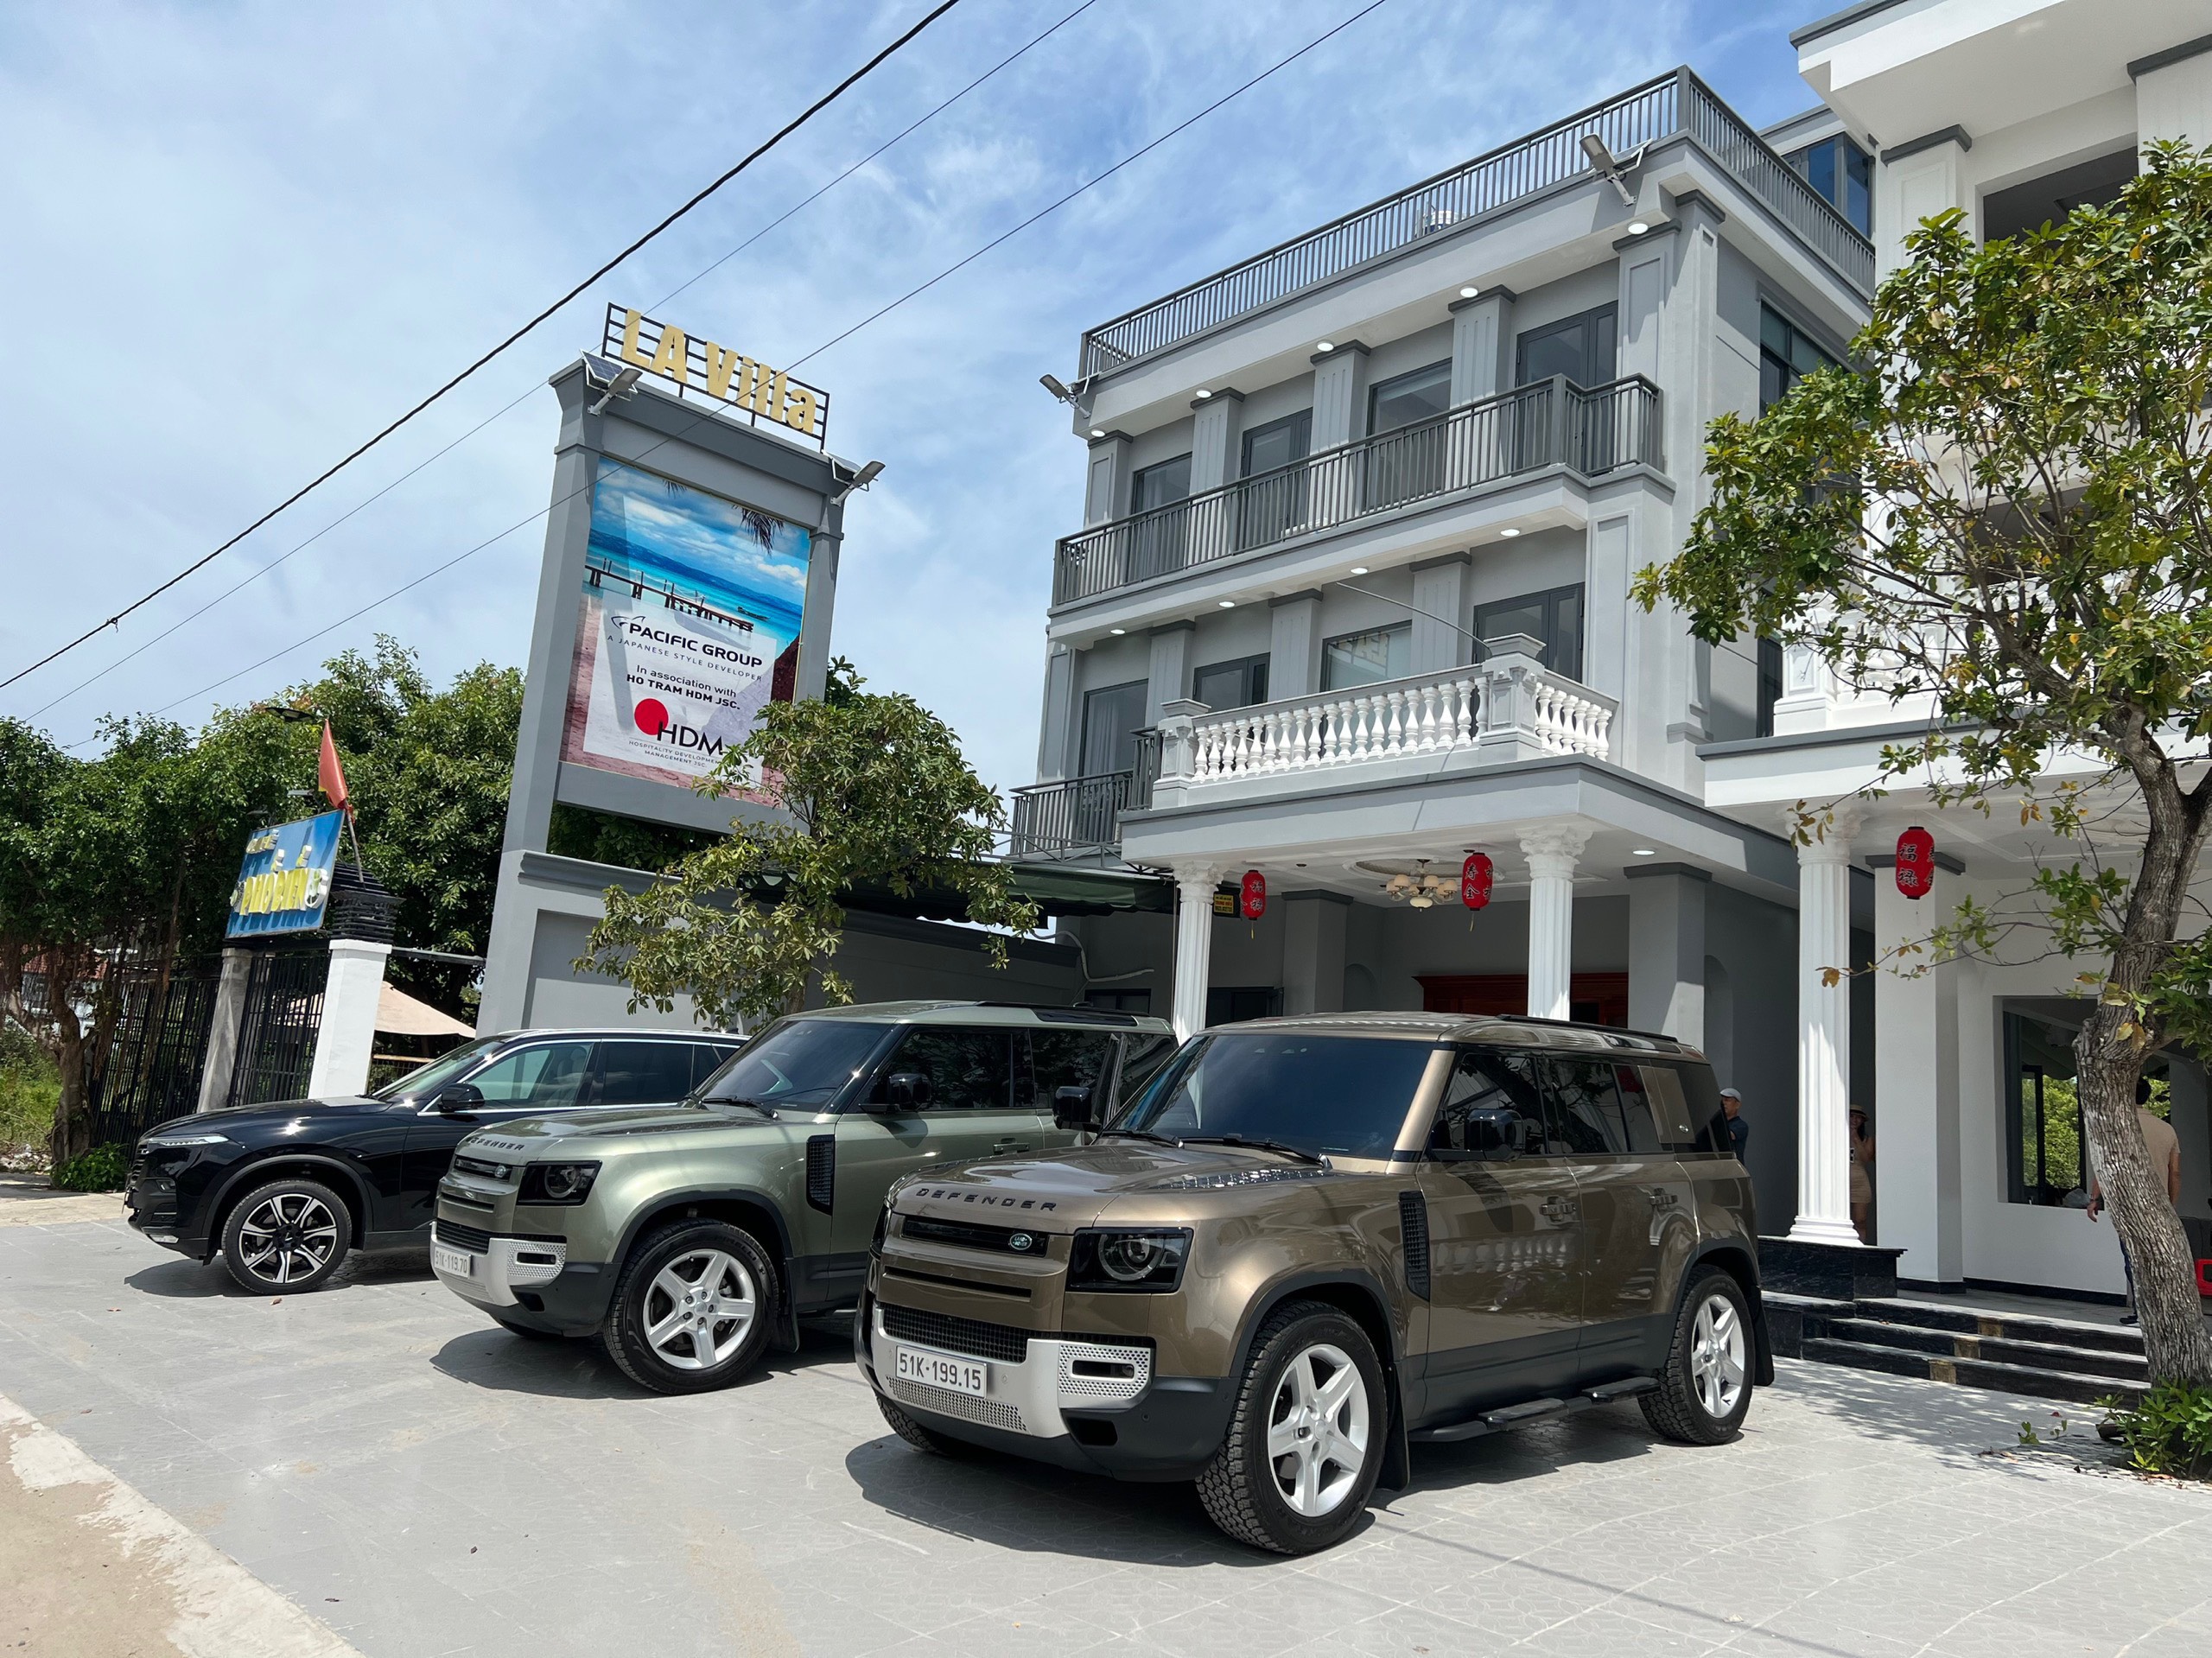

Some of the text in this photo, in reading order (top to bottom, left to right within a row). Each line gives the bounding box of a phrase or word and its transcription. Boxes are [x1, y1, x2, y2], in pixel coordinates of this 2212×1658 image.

[620, 308, 817, 435] LA Villa
[618, 638, 670, 657] JAPANESE
[674, 652, 702, 665] STYLE
[707, 661, 762, 682] DEVELOPER
[629, 623, 763, 668] PACIFIC GROUP
[626, 674, 741, 710] HO TRAM HDM JSC.
[636, 664, 736, 698] In association with
[629, 740, 722, 765] HOSPITALITY DEVELOPMEN
[657, 720, 723, 757] HDM
[645, 750, 692, 765] MANAGEMENT
[916, 1188, 1057, 1211] DEFENDER
[899, 1353, 981, 1391] 51K-199.15
